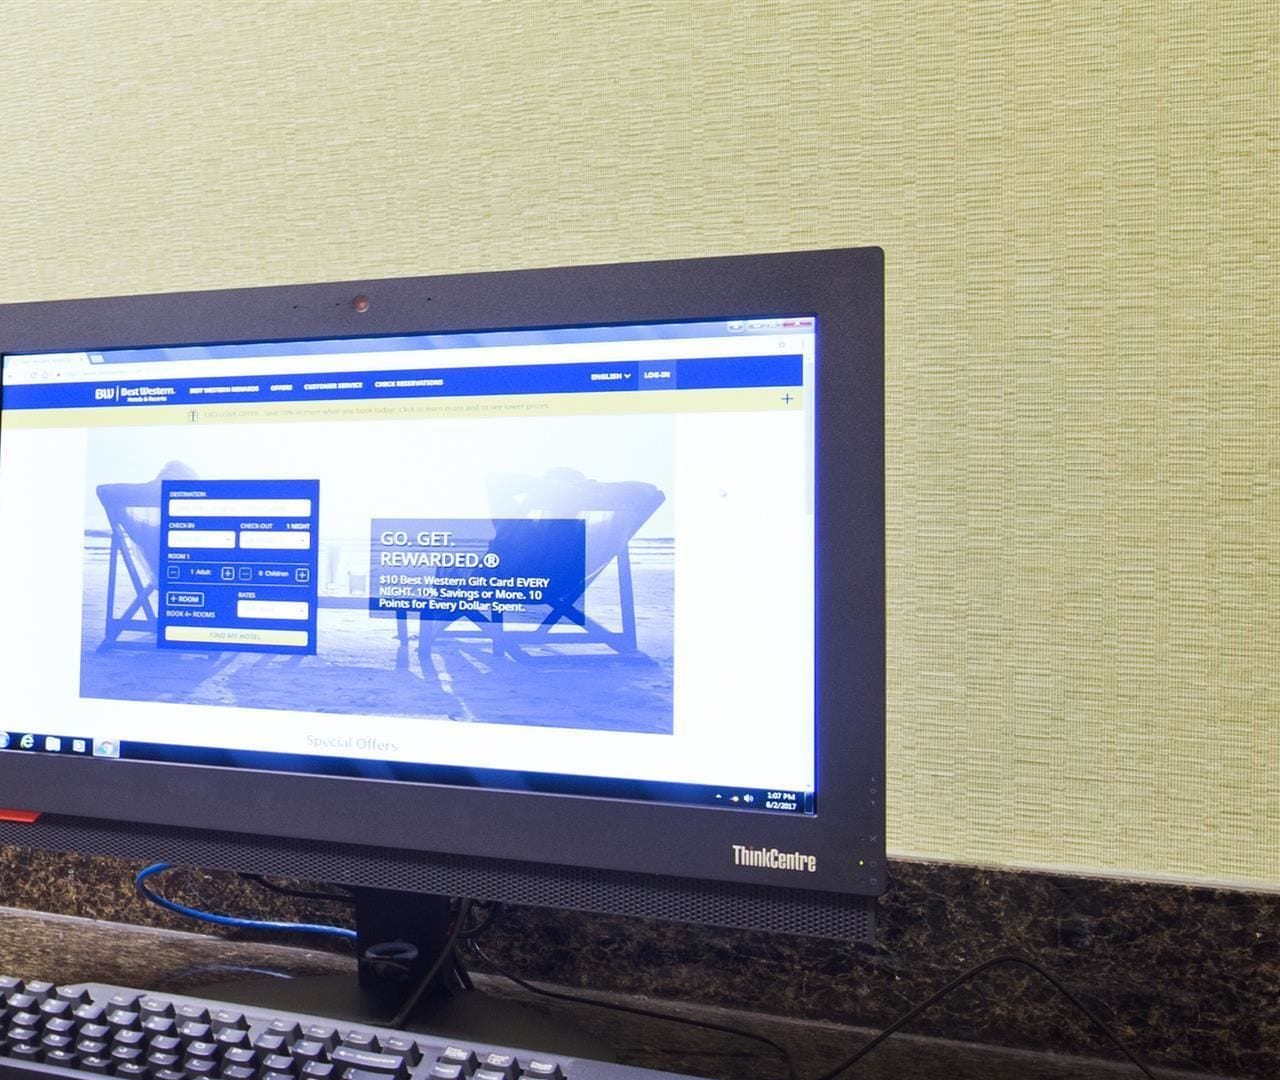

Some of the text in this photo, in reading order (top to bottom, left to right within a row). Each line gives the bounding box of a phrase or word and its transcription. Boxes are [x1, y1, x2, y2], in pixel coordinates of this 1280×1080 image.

[591, 372, 622, 381] ENGLISH
[644, 371, 670, 379] LOG-IN
[303, 381, 363, 390] CUSTOMER SERVICE
[396, 379, 444, 387] RESERVATIONS
[121, 387, 139, 396] Best
[270, 384, 293, 392] OFFERS
[95, 388, 114, 400] BW
[381, 531, 456, 547] GO. GET.
[379, 574, 550, 588] $10 Best Western Gift Card EVERY
[379, 587, 542, 601] NIGHT. 10% Savings or More. 10
[379, 599, 526, 614] Points for Every Dollar Spent.
[193, 611, 216, 619] ROOMS
[240, 633, 262, 641] HOTEL
[306, 734, 399, 752] Special Offers
[783, 792, 796, 801] PM
[732, 845, 817, 873] ThinkCentre
